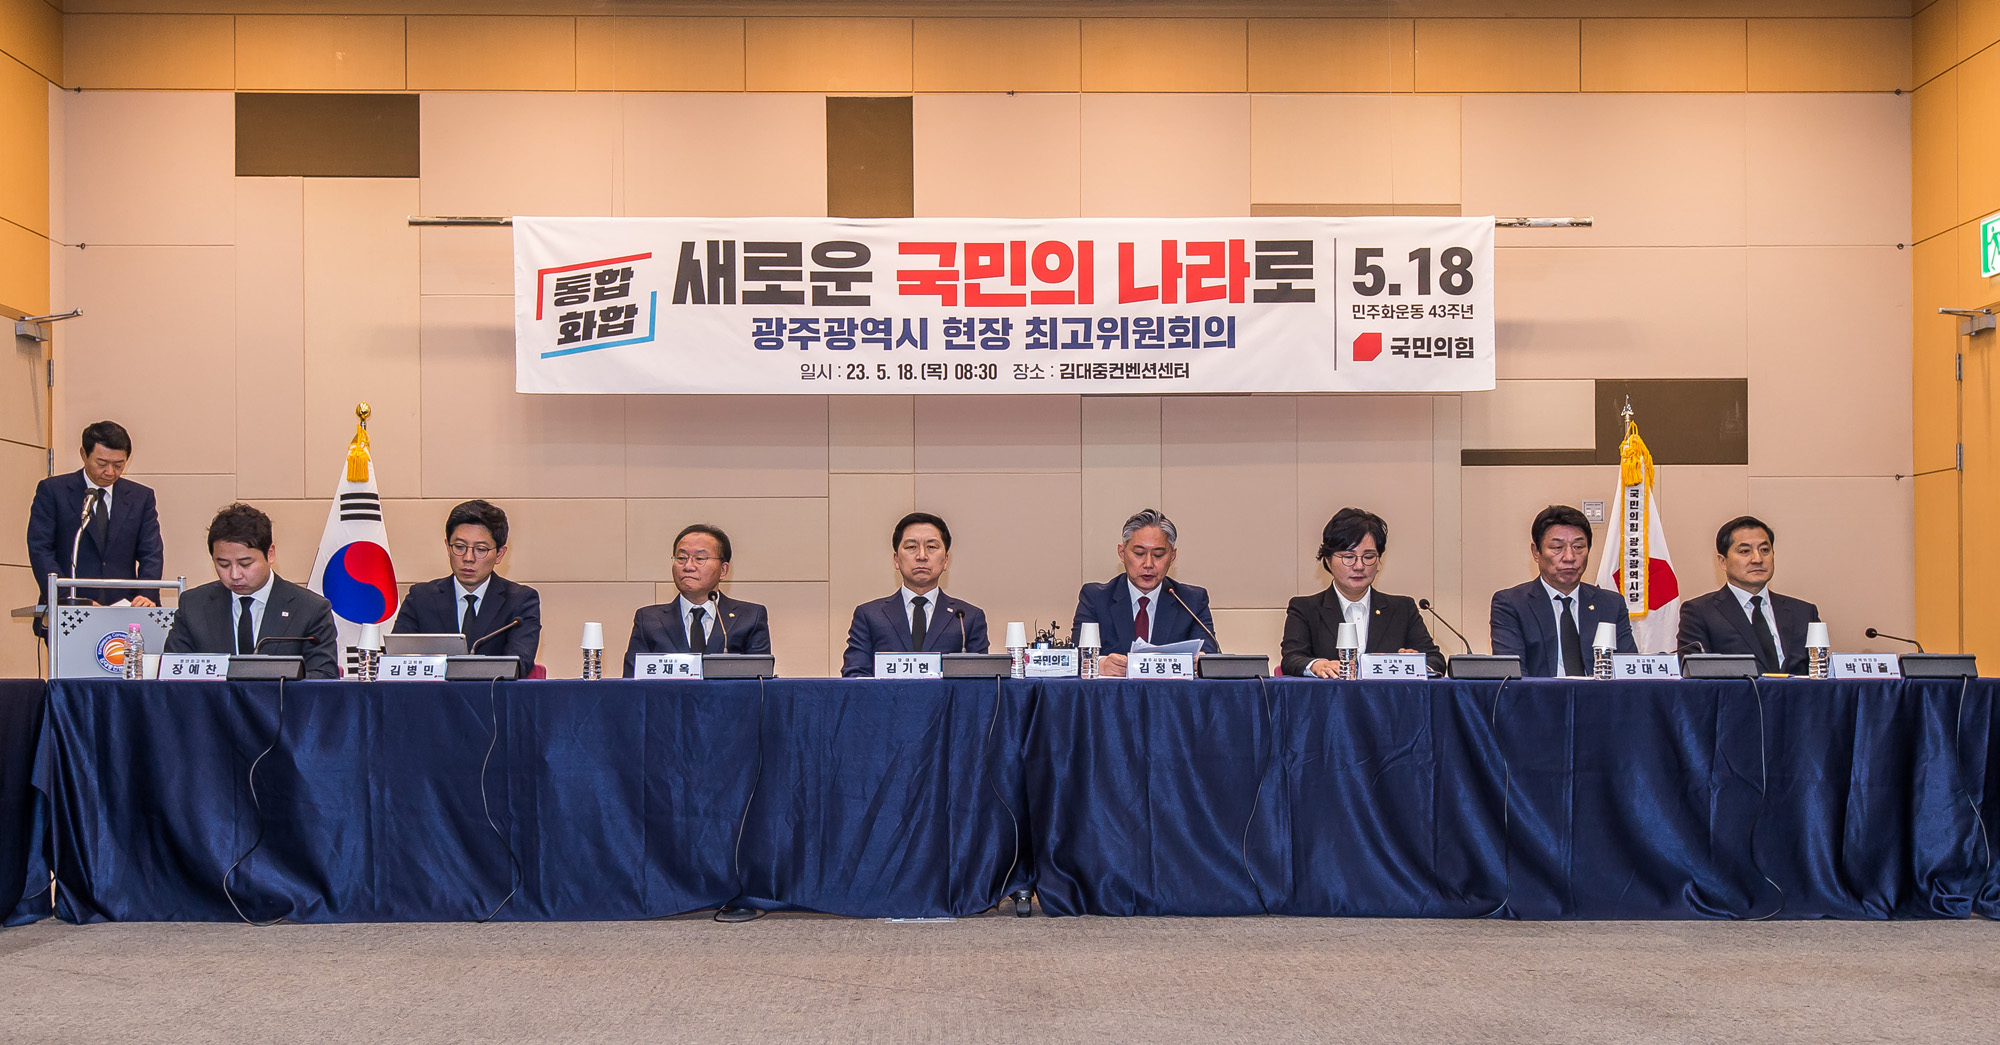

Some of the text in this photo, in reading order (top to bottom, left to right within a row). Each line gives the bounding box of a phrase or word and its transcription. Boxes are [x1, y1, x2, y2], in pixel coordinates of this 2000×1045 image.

[554, 266, 634, 307] 통합
[672, 237, 1316, 308] 새로운 국민의 나라로
[1353, 247, 1474, 297] 5.18
[557, 303, 639, 346] 화합
[1353, 303, 1474, 320] 민주화운동 43주년
[752, 315, 1237, 352] 광주광역시 현장 최고위원회의
[1390, 337, 1475, 360] 국민의힘
[801, 364, 832, 380] 일시
[847, 364, 870, 380] 23.
[877, 364, 891, 380] 5.
[955, 364, 998, 380] 08:30
[1013, 364, 1046, 380] 장소
[1060, 363, 1190, 380] 김대중컨벤션센터
[1629, 489, 1640, 603] 국민의힘 광주광역시당
[1033, 655, 1070, 667] 국민의힘
